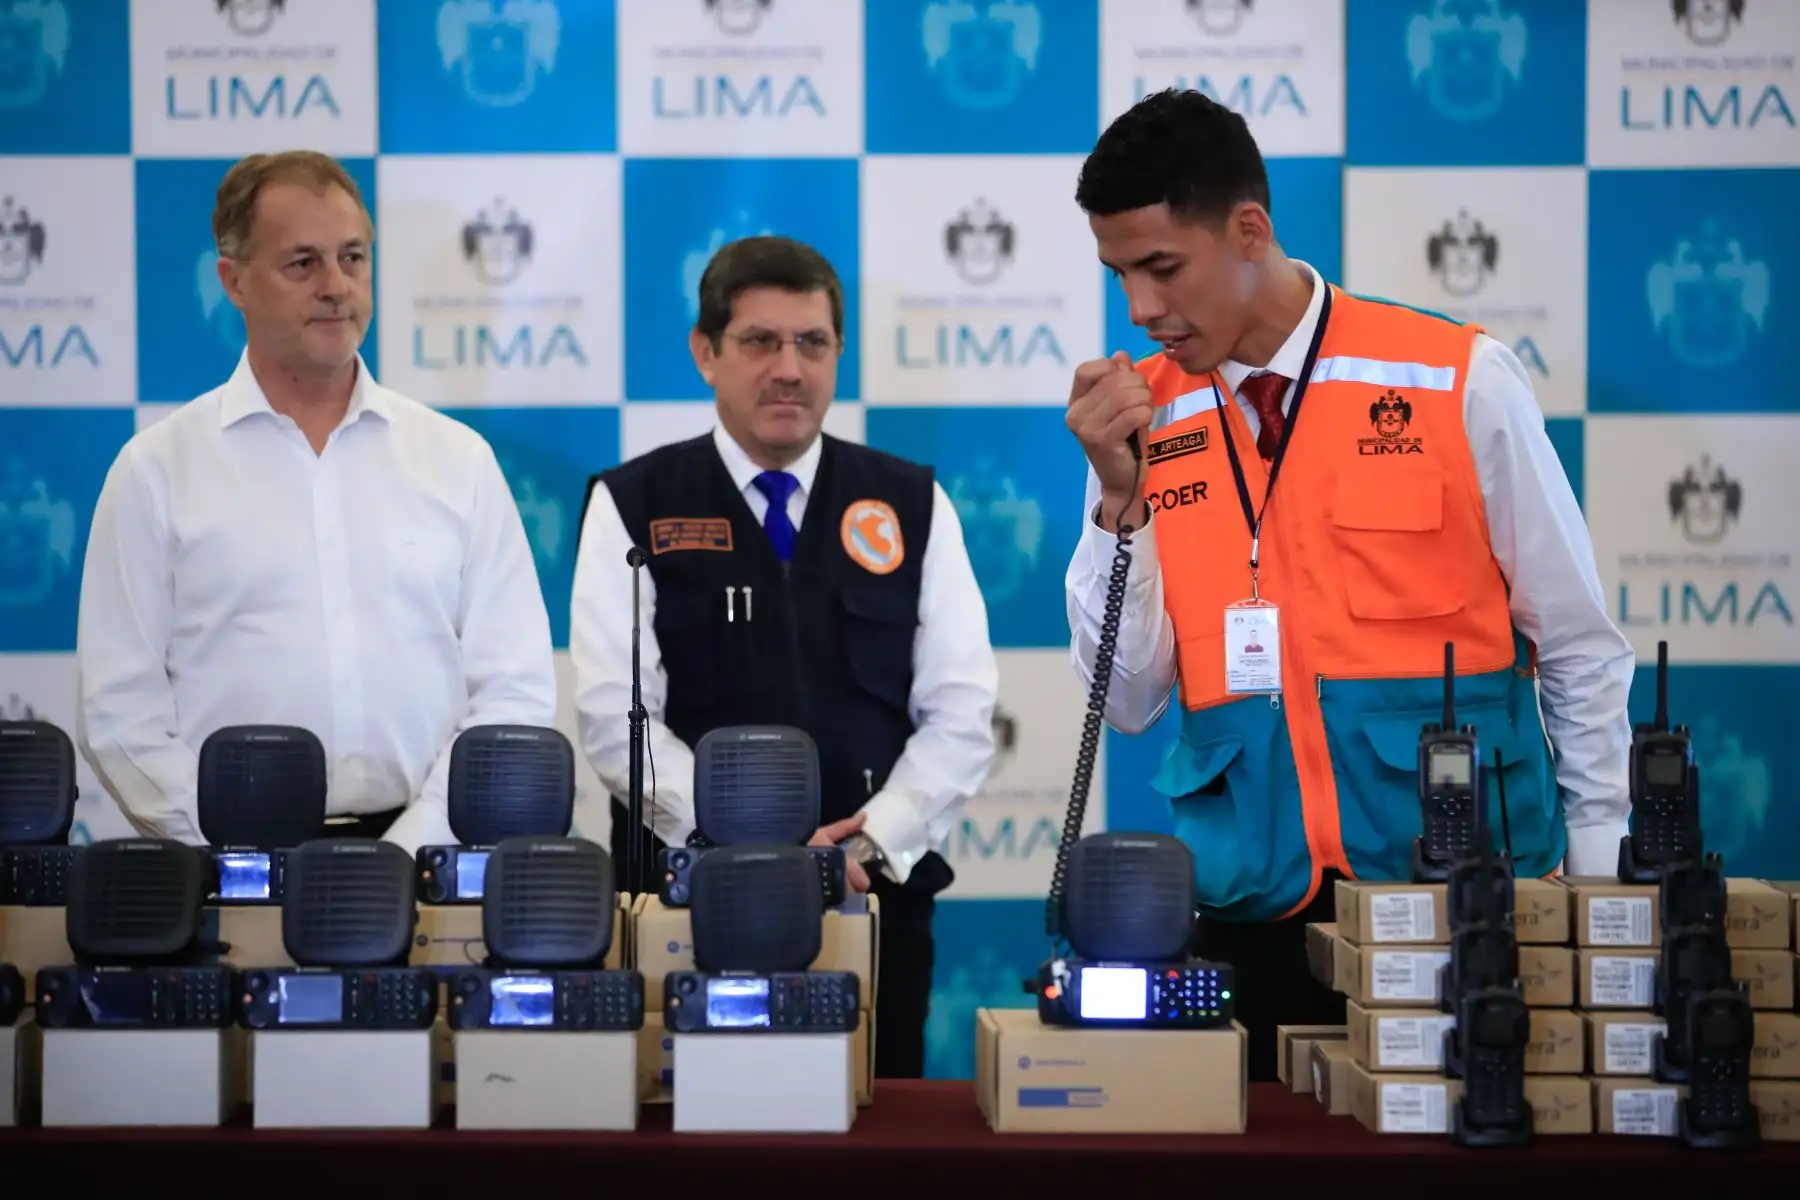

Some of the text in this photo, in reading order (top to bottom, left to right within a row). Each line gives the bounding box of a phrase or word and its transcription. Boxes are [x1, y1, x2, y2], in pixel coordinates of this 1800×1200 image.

[165, 74, 342, 120] LIMA
[652, 74, 827, 119] LIMA
[1621, 85, 1796, 129] LIMA
[412, 324, 590, 369] LIMA
[896, 324, 1070, 369] LIMA
[1160, 434, 1202, 453] ARTEAGA
[1358, 445, 1424, 455] LIMA
[1148, 480, 1208, 514] COER
[1619, 580, 1794, 627] LIMA
